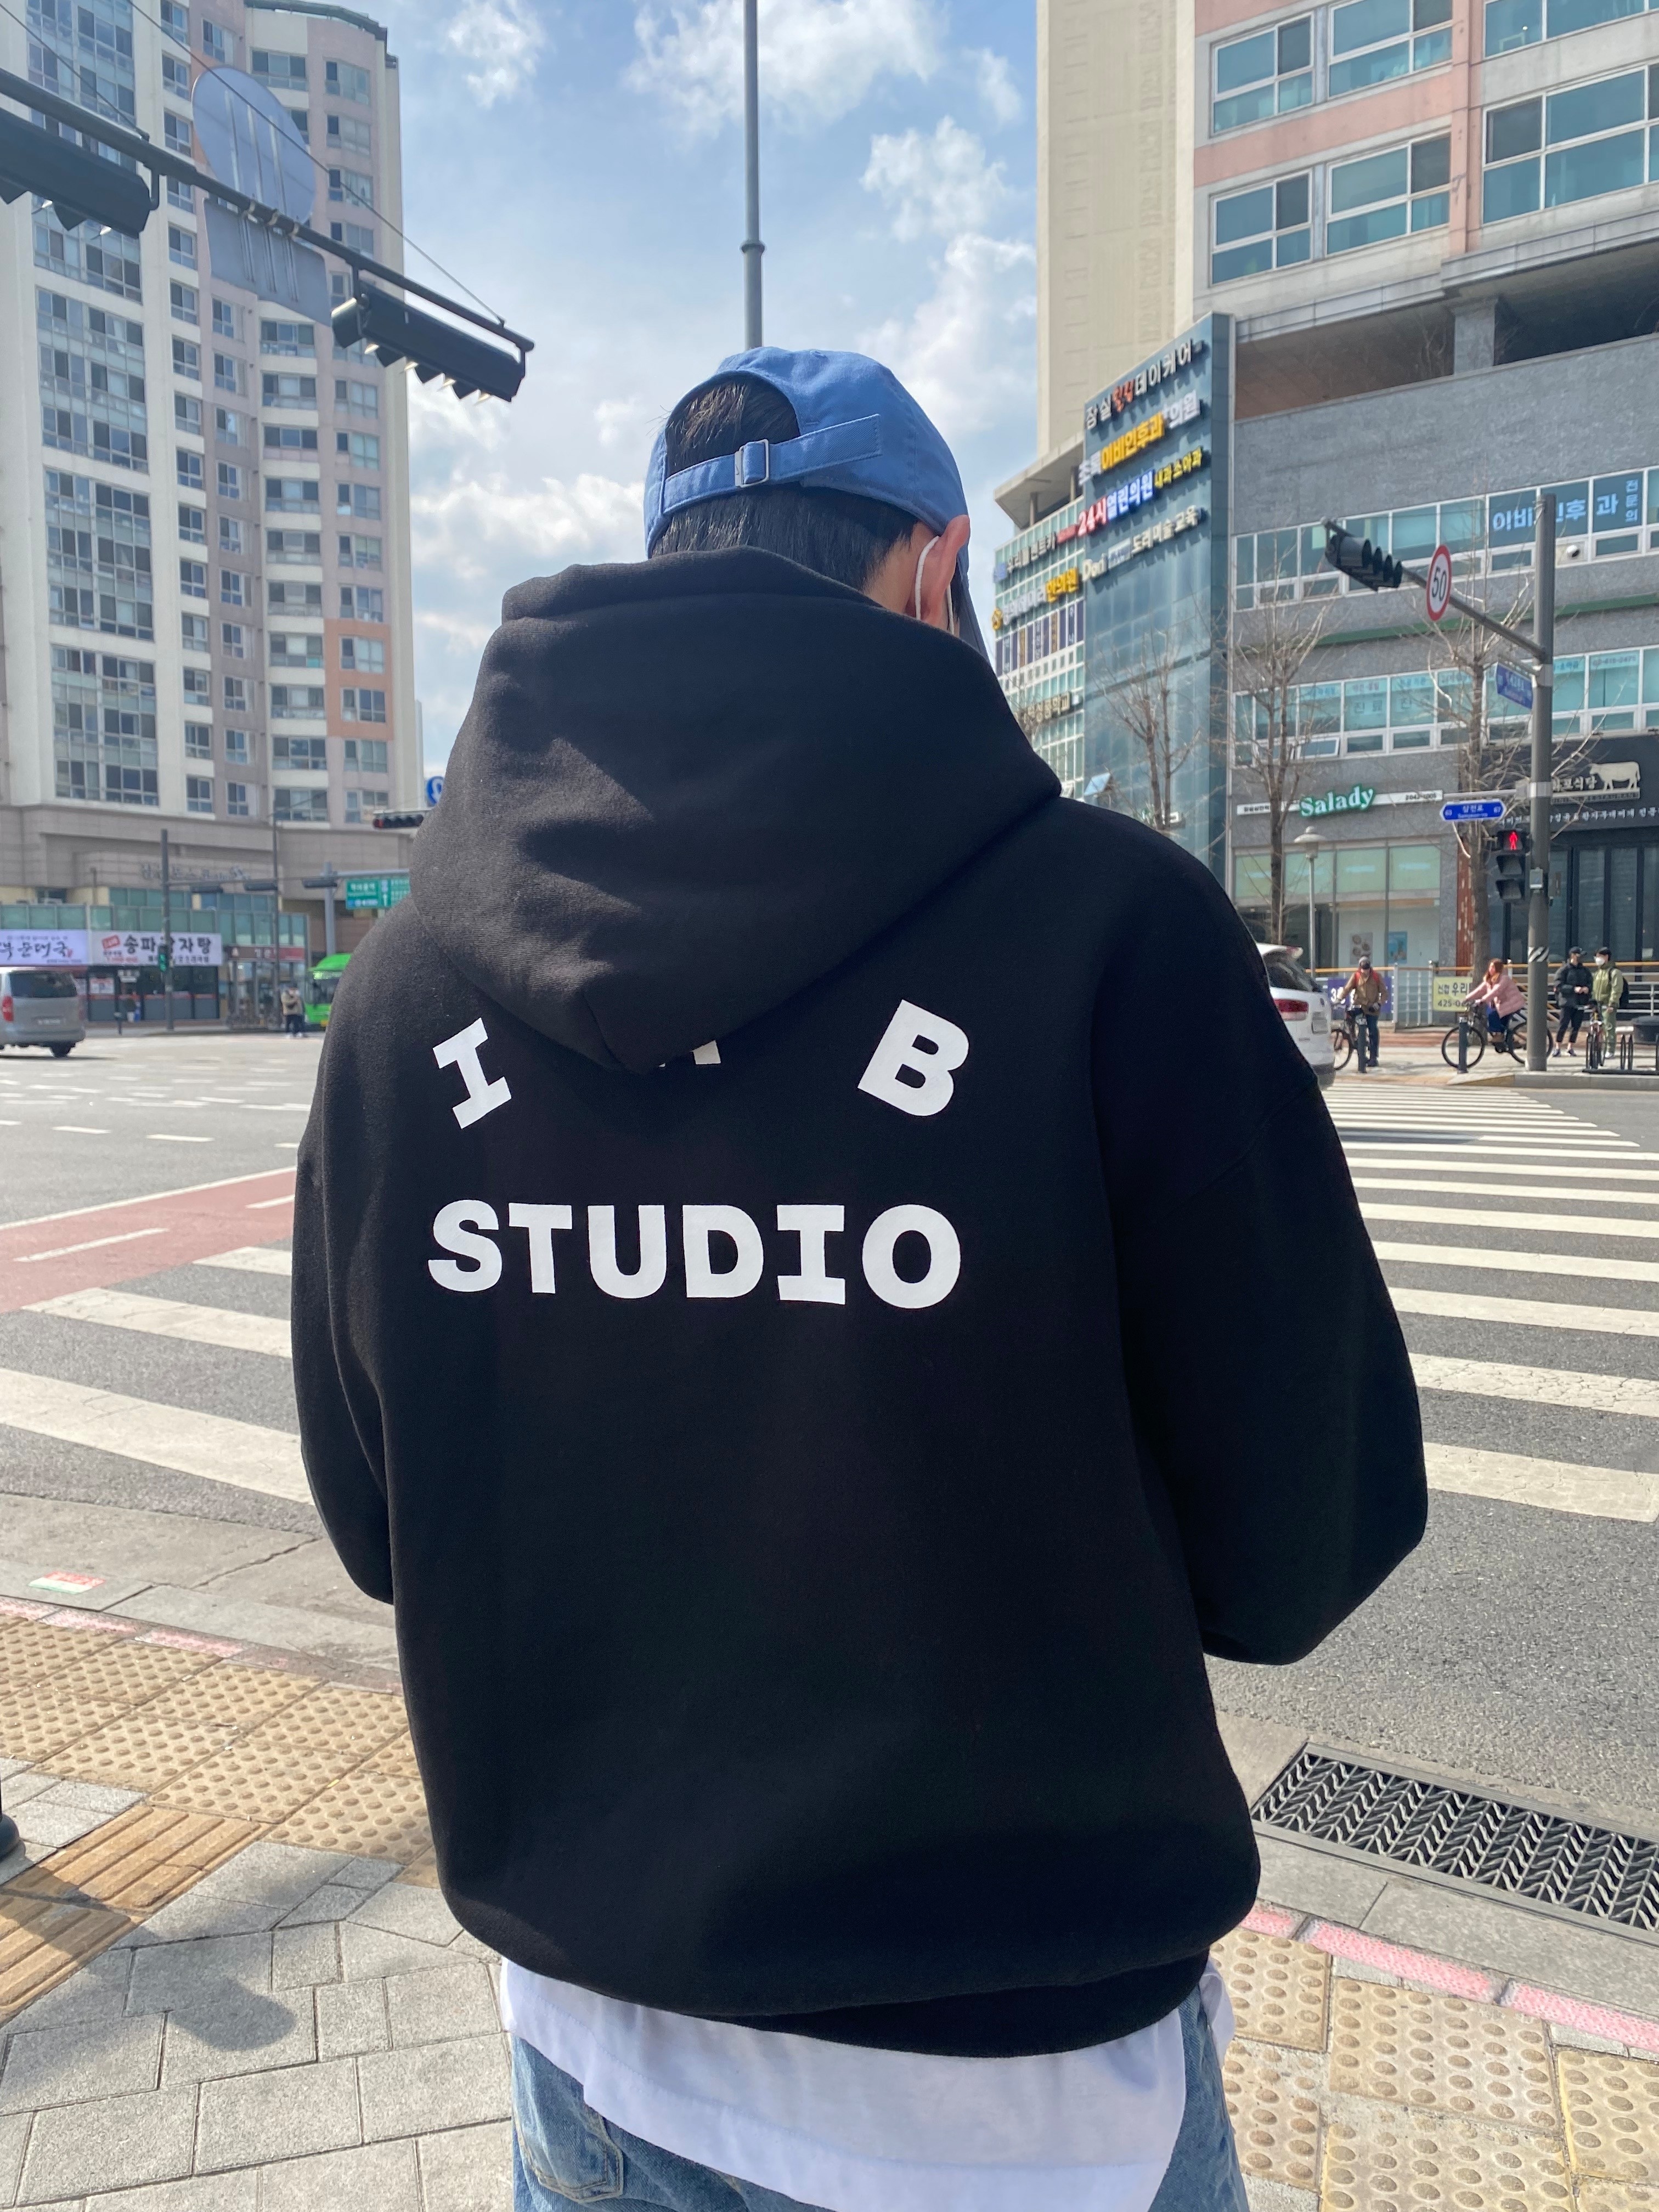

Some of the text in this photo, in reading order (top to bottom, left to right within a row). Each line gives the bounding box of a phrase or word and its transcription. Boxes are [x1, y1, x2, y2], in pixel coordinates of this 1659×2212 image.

[1431, 566, 1447, 602] 50
[1300, 786, 1374, 817] Salady
[123, 933, 212, 955] 송파자탕
[427, 1199, 961, 1310] STUDIO
